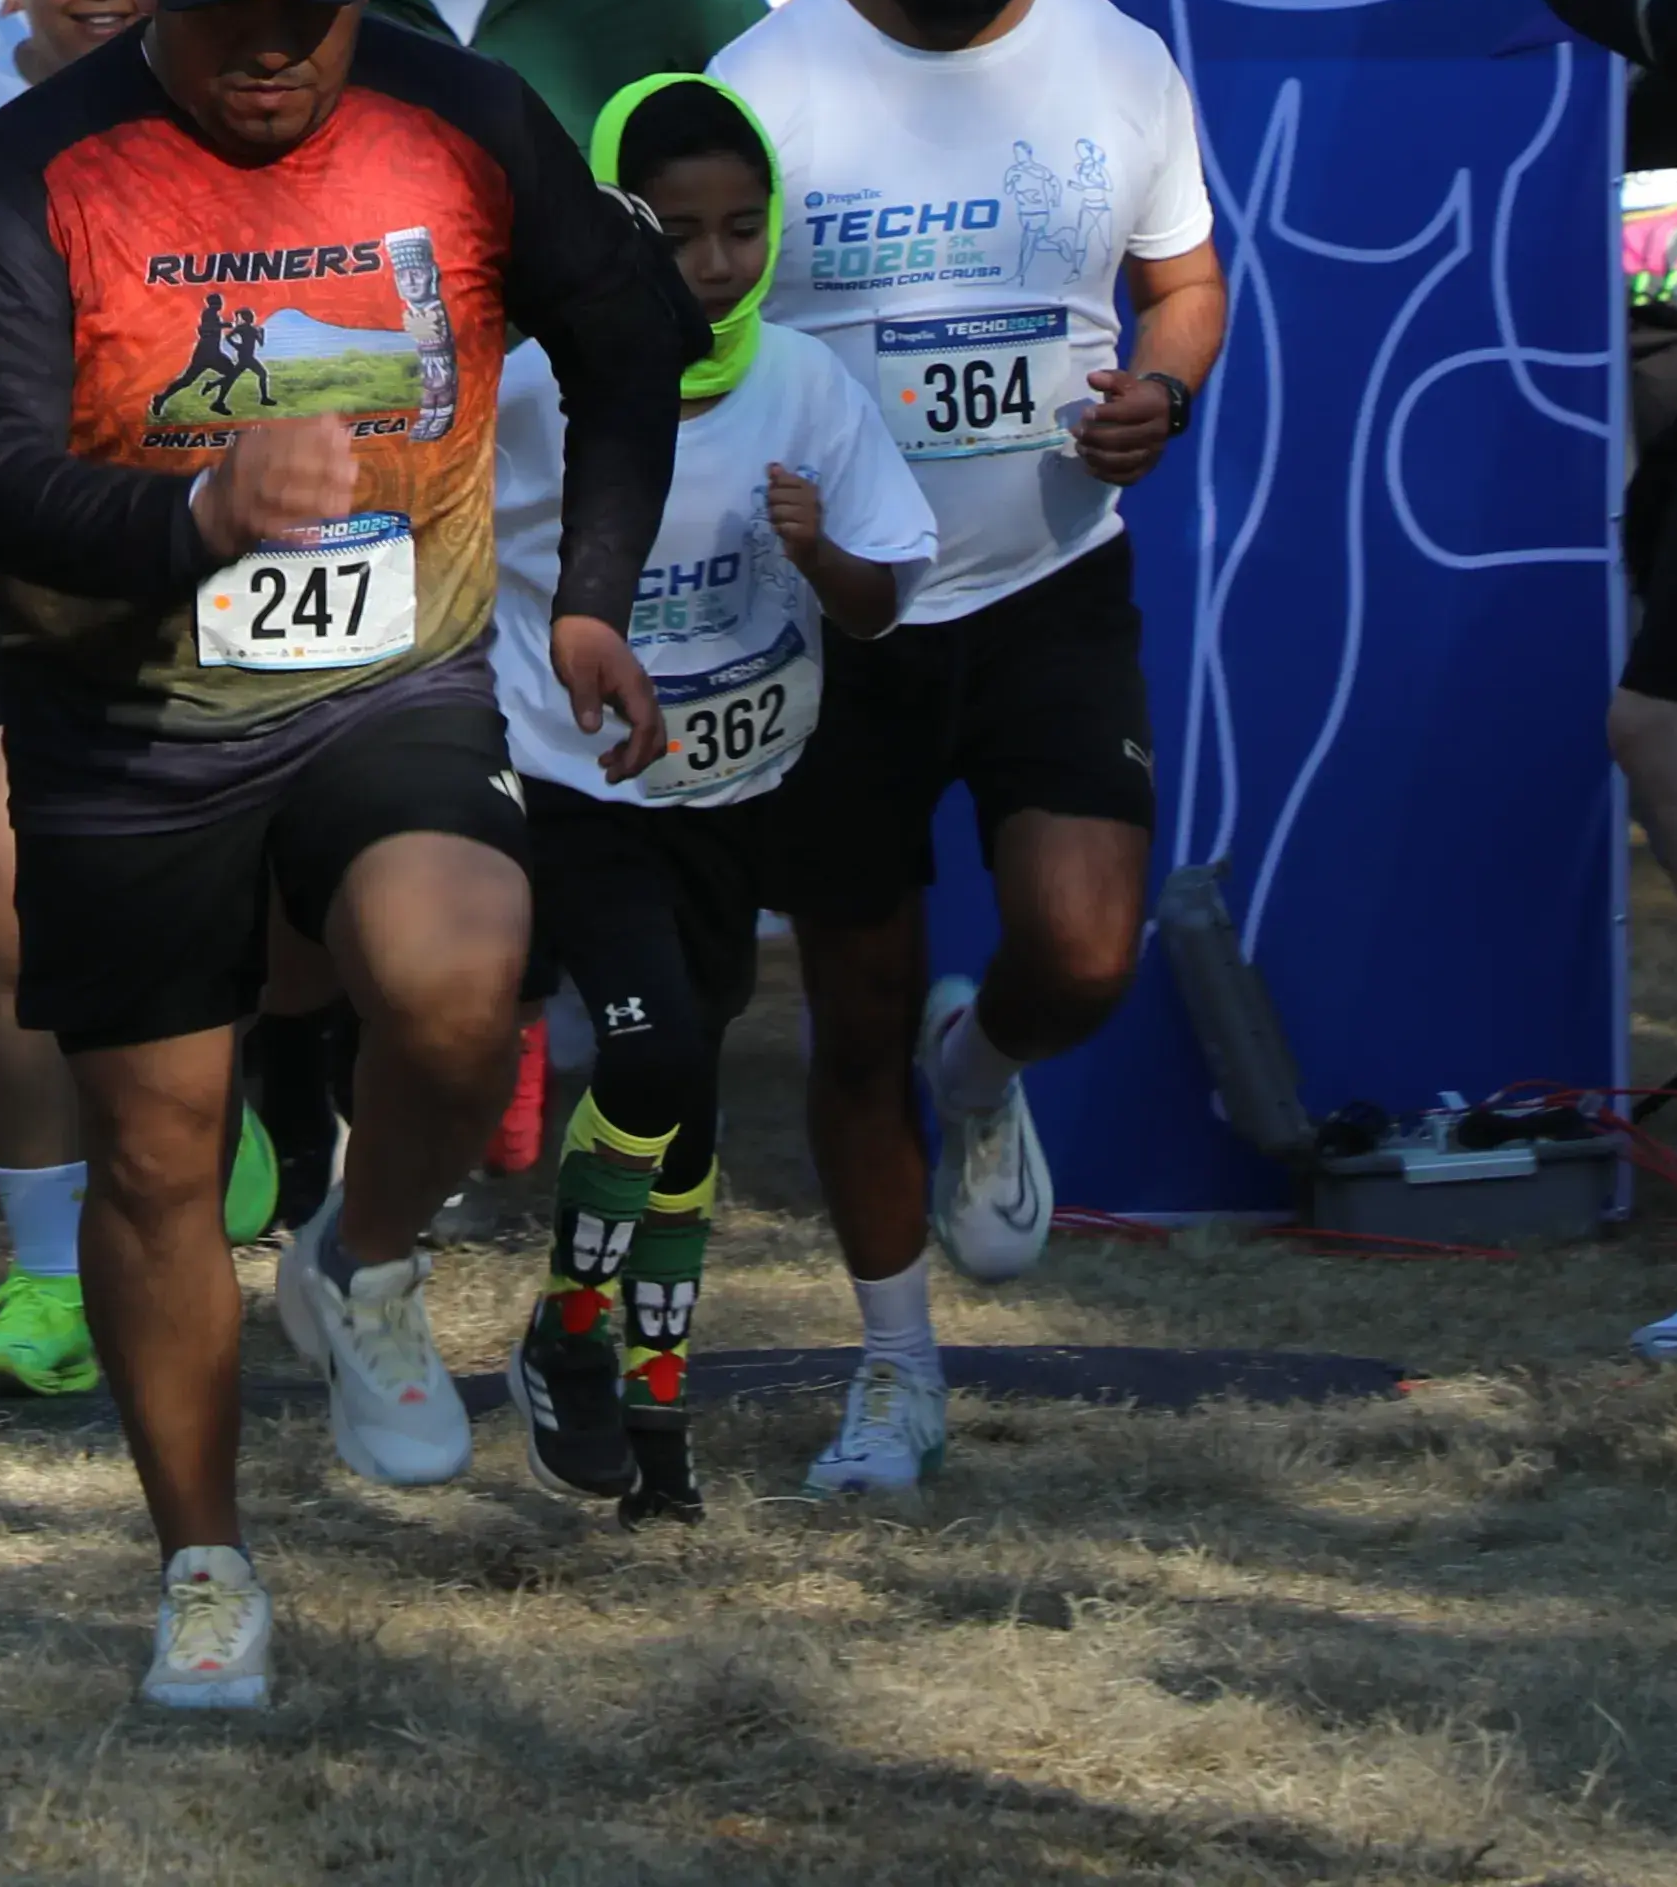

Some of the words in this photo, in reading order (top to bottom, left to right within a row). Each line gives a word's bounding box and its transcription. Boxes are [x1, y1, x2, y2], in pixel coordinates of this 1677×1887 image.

[805, 198, 1001, 246] TECHO
[146, 240, 384, 286] RUNNERS
[810, 237, 938, 280] 2026
[812, 275, 894, 291] CARRERA
[897, 271, 936, 286] CON
[939, 265, 1002, 281] CAUSA
[923, 355, 1036, 434] 364
[250, 560, 372, 640] 247
[634, 552, 742, 602] CHO
[685, 683, 786, 771] 362
